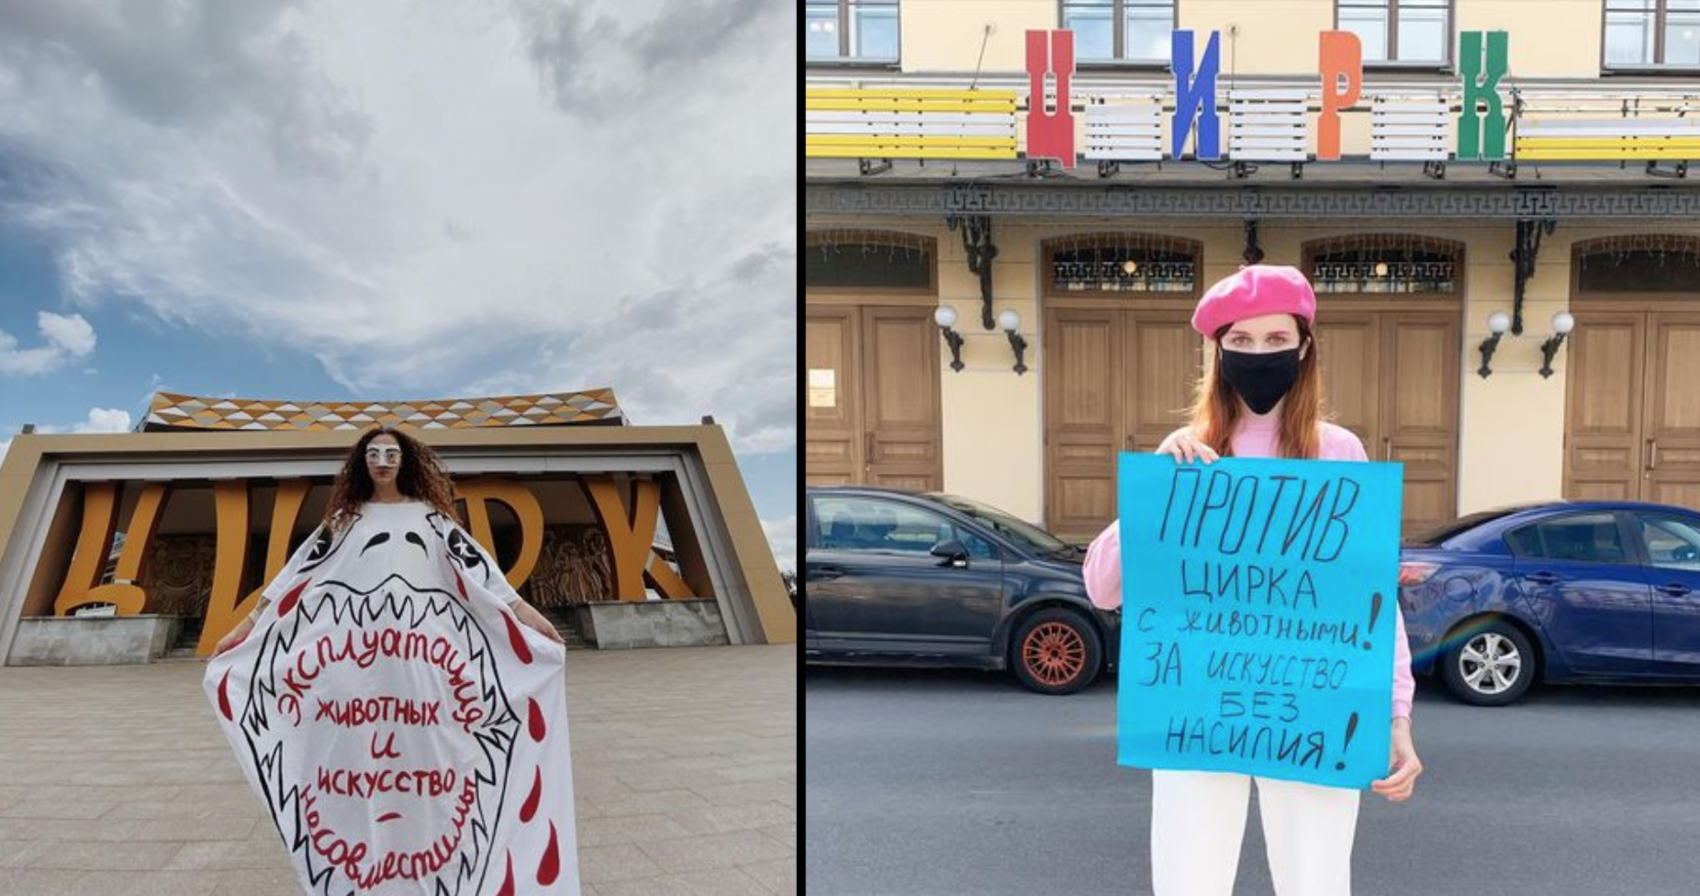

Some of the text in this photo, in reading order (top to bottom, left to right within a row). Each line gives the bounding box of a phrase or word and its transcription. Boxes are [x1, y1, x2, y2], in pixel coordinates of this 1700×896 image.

[1159, 467, 1361, 562] ПРОТИВ
[1181, 559, 1317, 609] ЦИРКА
[1135, 641, 1182, 687] ЗА
[1219, 692, 1301, 722] БЕЗ
[317, 766, 456, 799] ИСКУССТВО
